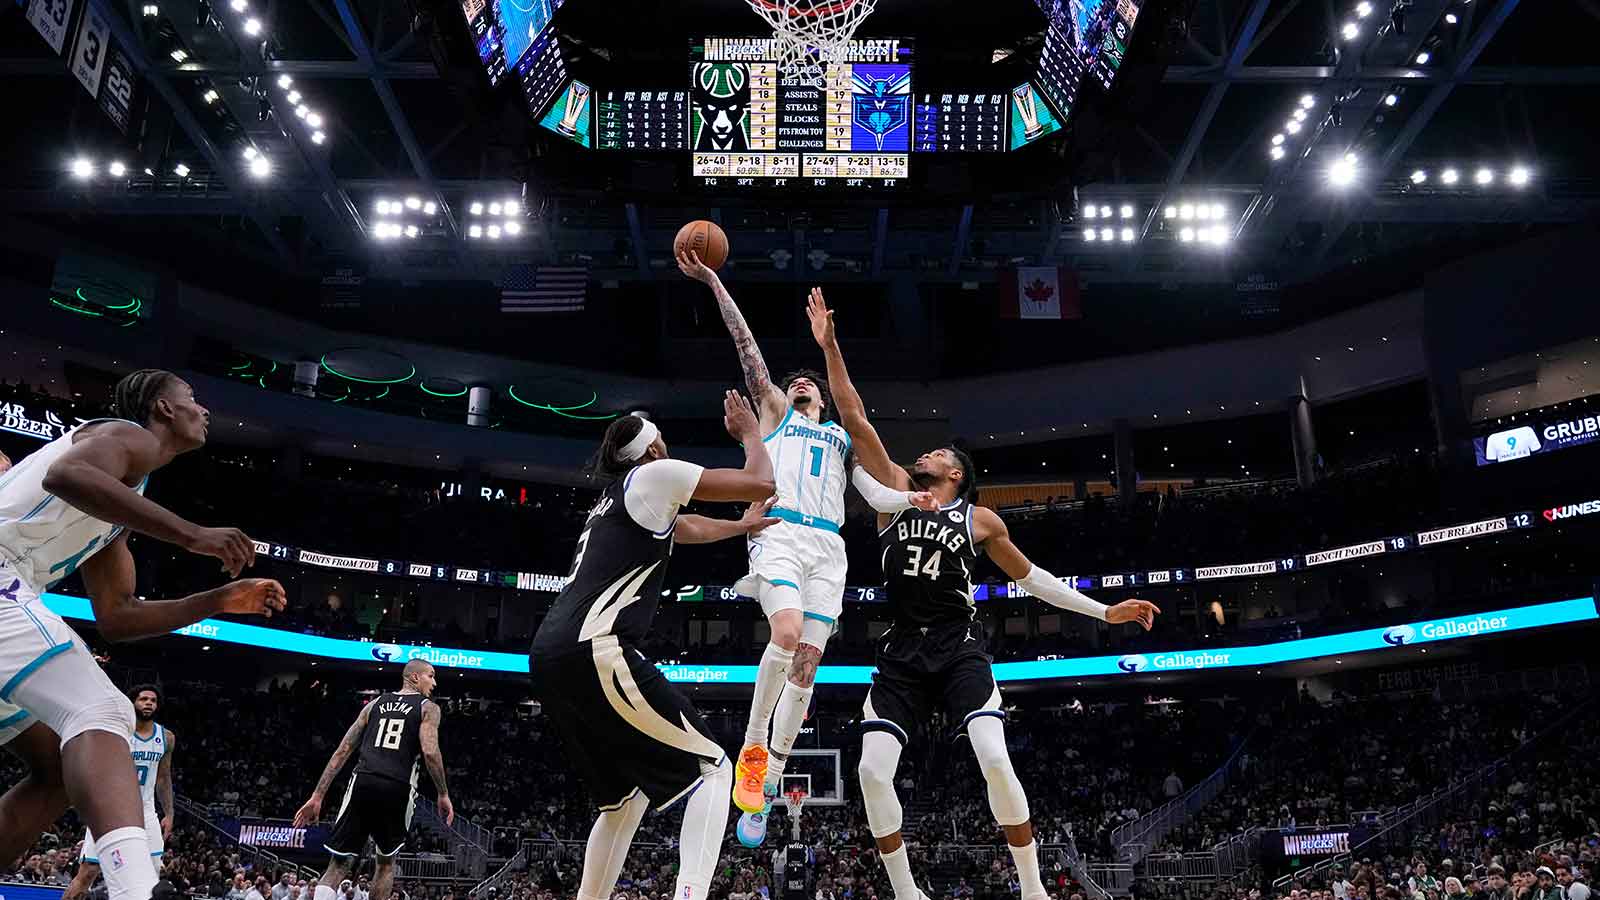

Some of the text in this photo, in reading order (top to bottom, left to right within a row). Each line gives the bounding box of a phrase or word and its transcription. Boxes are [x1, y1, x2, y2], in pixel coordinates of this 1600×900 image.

[84, 31, 100, 70] 3
[760, 65, 766, 74] 2
[108, 66, 132, 109] 22
[758, 78, 769, 86] 14
[758, 90, 769, 99] 18
[834, 91, 845, 99] 19
[941, 94, 953, 104] PTS
[760, 103, 767, 111] 4
[785, 103, 818, 112] STEALS
[836, 103, 842, 112] 7
[761, 115, 766, 123] 1
[784, 115, 820, 123] BLOCKS
[836, 115, 841, 123] 1
[760, 127, 766, 135] 8
[778, 128, 824, 136] PTS FROM TOV
[834, 127, 845, 136] 19
[761, 139, 766, 147] 1
[836, 139, 841, 148] 1
[697, 156, 795, 165] 26-40 9-18 8-11
[806, 157, 905, 166] 27-49 9-23 13-15
[737, 178, 754, 186] 3PT
[775, 178, 787, 186] FT
[846, 179, 863, 187] 3PT
[884, 179, 896, 187] FT
[0, 401, 25, 419] AR
[3, 414, 53, 437] DEER
[1543, 415, 1600, 440] GRUB
[1507, 436, 1517, 450] 9
[810, 445, 824, 477] 1
[1420, 514, 1529, 543] FAST BREAK PTS 12
[897, 519, 966, 553] BUCKS
[273, 546, 288, 558] 21
[1308, 538, 1405, 564] BENCH POINTS 18
[301, 552, 394, 573] POINTS FROM TOV 8
[903, 545, 942, 581] 34
[411, 566, 444, 577] TOL 5
[1197, 559, 1294, 578] POINTS FROM TOV 19
[458, 569, 490, 582] FLS 1
[1104, 575, 1136, 586] FLS 1
[1150, 570, 1183, 582] TOL 5
[720, 588, 737, 600] 69
[857, 588, 875, 600] 76
[1421, 615, 1508, 637] Gallagher
[408, 647, 484, 667] Gallagher
[1153, 653, 1232, 669] Gallagher
[379, 702, 413, 715] KUZMA
[374, 718, 405, 750] 18
[256, 831, 290, 842] BUCKS
[1301, 839, 1334, 849] BUCKS
